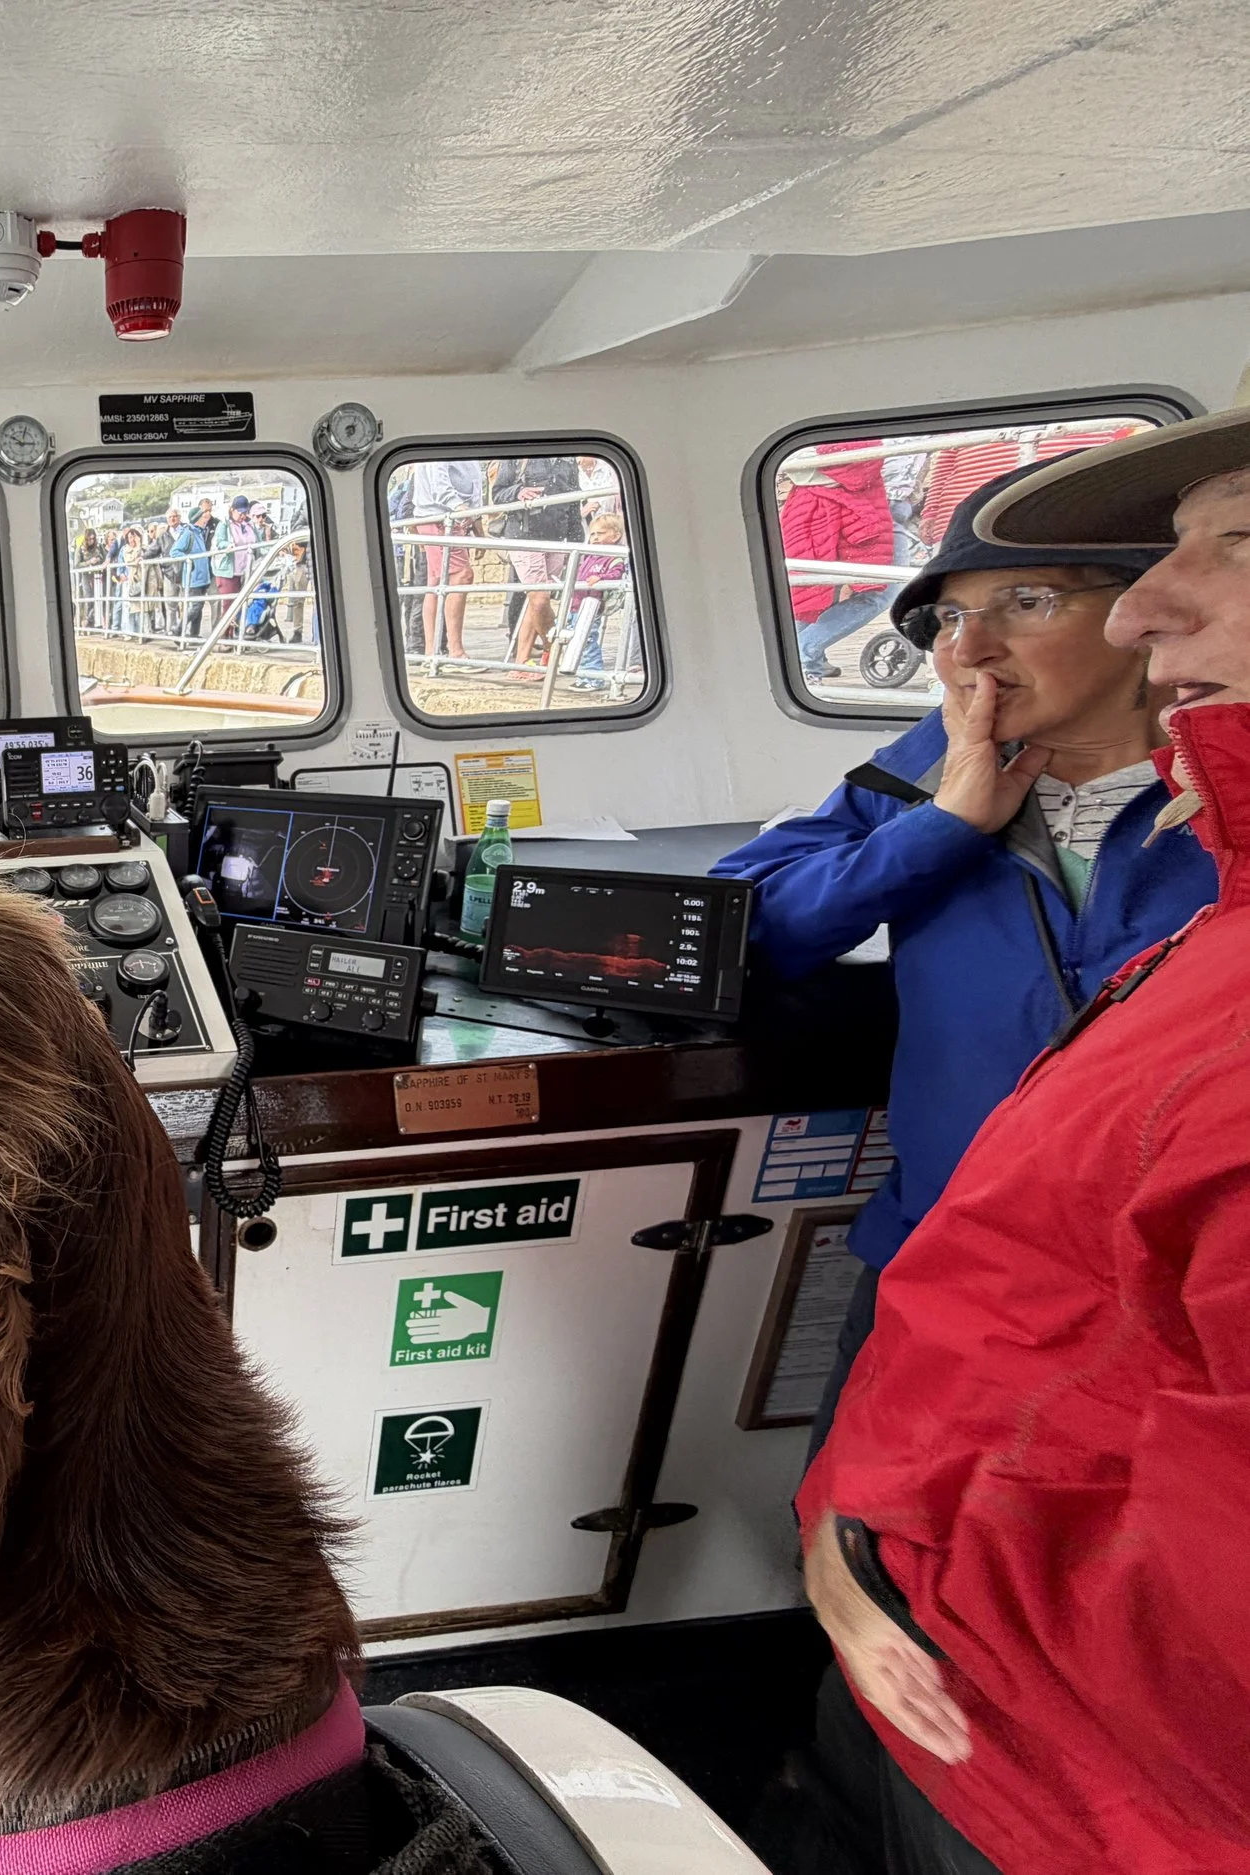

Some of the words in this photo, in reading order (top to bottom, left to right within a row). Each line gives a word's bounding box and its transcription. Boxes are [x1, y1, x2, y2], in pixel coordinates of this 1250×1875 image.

[143, 395, 158, 404] MV
[159, 394, 206, 404] SAPPHIRE
[102, 433, 122, 441] CALL
[76, 765, 93, 781] 36
[676, 958, 698, 966] 10:02
[403, 1076, 450, 1089] SAPPHIRE
[457, 1074, 469, 1085] OF
[426, 1202, 508, 1234] First
[516, 1195, 572, 1226] aid
[395, 1347, 434, 1363] First
[437, 1344, 462, 1359] aid
[466, 1343, 487, 1357] kit
[406, 1471, 441, 1480] Rocket
[382, 1481, 432, 1493] parachute
[434, 1479, 462, 1487] flares
